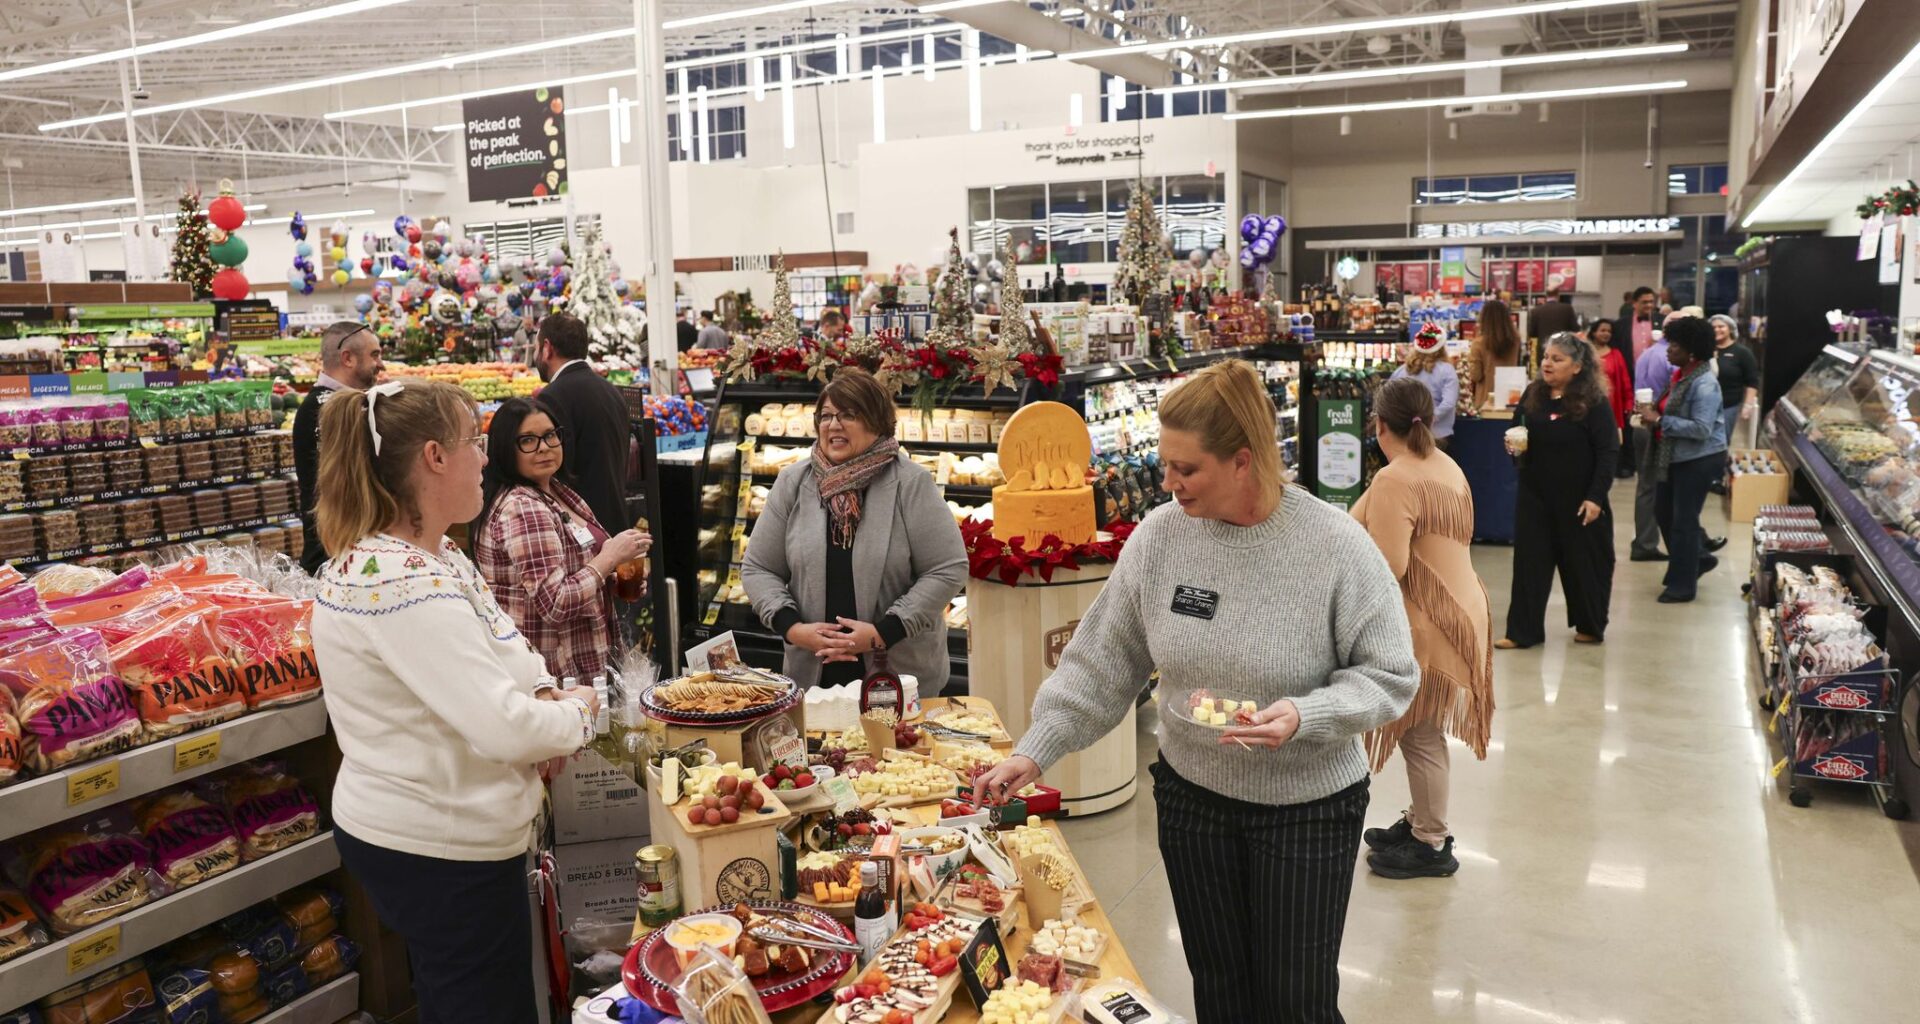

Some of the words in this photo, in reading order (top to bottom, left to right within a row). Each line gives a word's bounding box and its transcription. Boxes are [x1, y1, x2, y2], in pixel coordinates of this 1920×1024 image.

[468, 117, 506, 134] Picked
[508, 116, 521, 129] at
[469, 137, 489, 151] the
[490, 133, 520, 153] peak
[1025, 142, 1053, 152] thank
[1055, 142, 1074, 151] you
[1076, 138, 1090, 149] for
[1092, 136, 1140, 147] shopping
[1142, 133, 1154, 143] at
[470, 153, 482, 167] of
[484, 148, 546, 170] perfection.
[1561, 217, 1670, 234] STARBUCKS
[0, 386, 27, 394] MEGA-3
[33, 385, 68, 393] DIGESTION
[1327, 404, 1353, 418] fresh
[1331, 418, 1353, 426] pass
[64, 443, 86, 451] LOCAL
[105, 439, 126, 447] LOCAL
[182, 432, 200, 440] LOCAL
[215, 428, 234, 436] LOCAL
[101, 490, 122, 499] LOCAL
[179, 480, 198, 489] LOCAL
[280, 466, 296, 474] LOCAL
[181, 529, 199, 538] LOCAL
[245, 518, 263, 527] LOCAL
[278, 513, 296, 521] LOCAL
[1825, 697, 1860, 706] WATSON
[575, 771, 599, 779] Bread
[1822, 766, 1856, 776] WATSON
[567, 871, 601, 882] BREAD
[605, 869, 611, 877] &
[91, 876, 138, 905] NAAN
[585, 900, 608, 908] Bread
